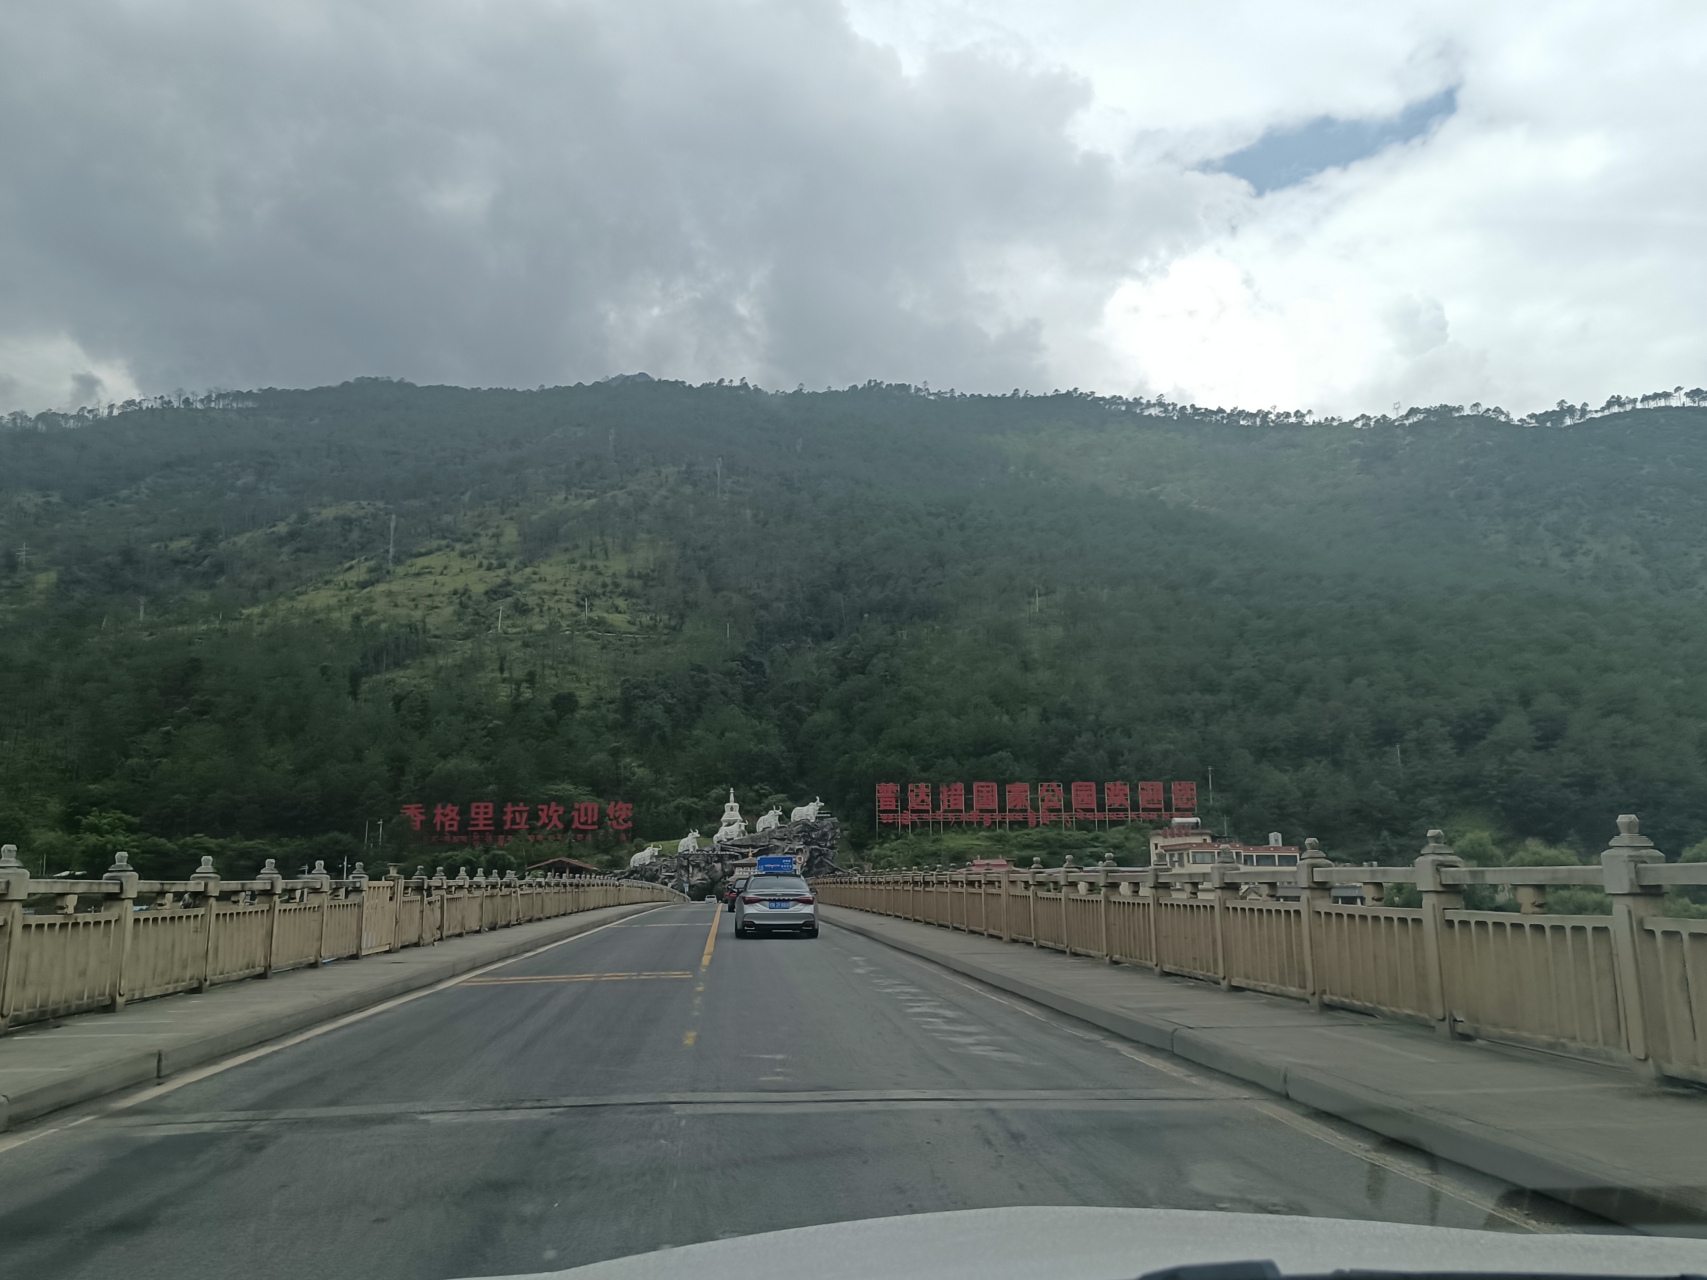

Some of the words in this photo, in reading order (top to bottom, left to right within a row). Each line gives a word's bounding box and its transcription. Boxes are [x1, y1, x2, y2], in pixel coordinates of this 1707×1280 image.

[400, 801, 633, 832] 香格里拉欢迎您
